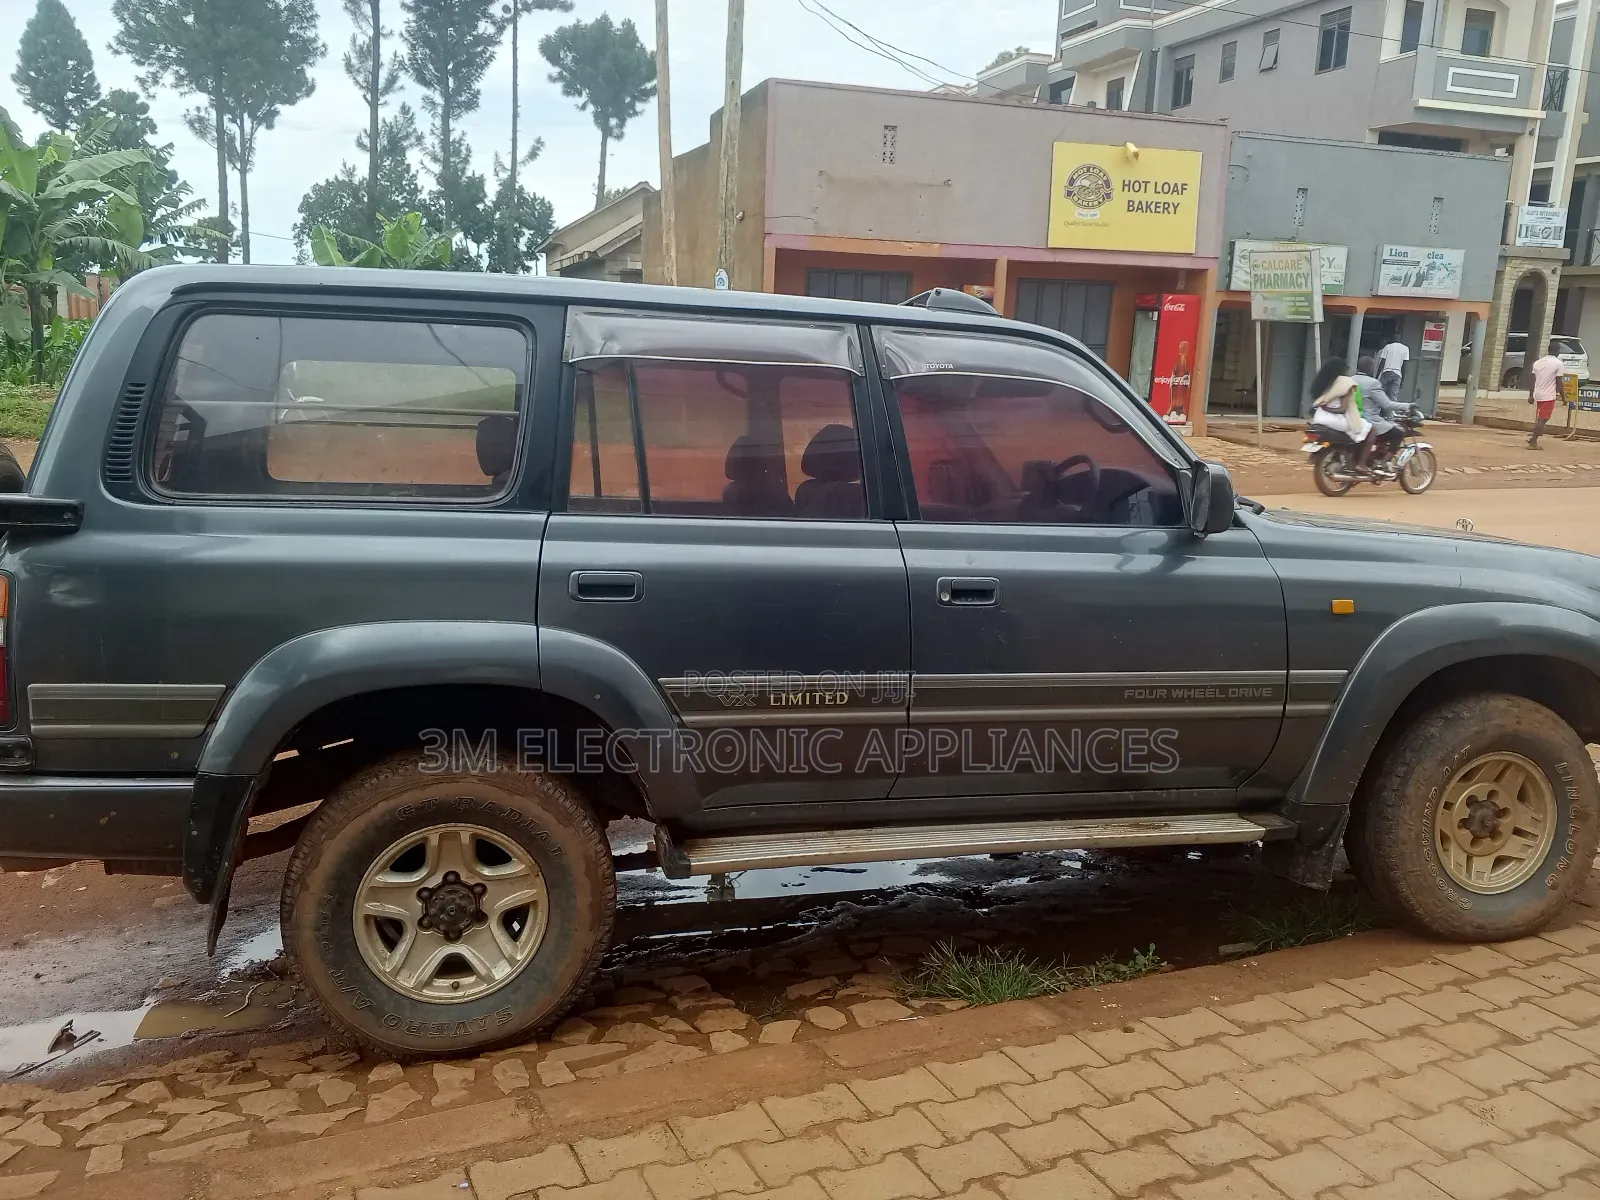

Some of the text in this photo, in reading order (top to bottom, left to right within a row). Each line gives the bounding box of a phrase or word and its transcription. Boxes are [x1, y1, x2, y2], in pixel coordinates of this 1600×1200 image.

[1073, 167, 1108, 180] HOT LOAF
[1122, 179, 1188, 196] HOT LOAF
[1072, 195, 1104, 207] BAKERY
[1127, 200, 1181, 215] BAKERY
[1388, 248, 1409, 258] Lion
[1261, 260, 1303, 271] CALCARE
[1253, 272, 1311, 290] PHARMACY
[925, 362, 954, 370] TOYOTA
[1154, 375, 1171, 385] enjoy
[1578, 390, 1600, 398] LION
[718, 692, 849, 707] VX LIMITED
[1124, 687, 1273, 699] FOUR WHEEL DRIVE
[396, 796, 565, 860] GT RADIAL
[1545, 761, 1581, 890] LINGLONG
[328, 968, 514, 1037] SAVERO A/T
